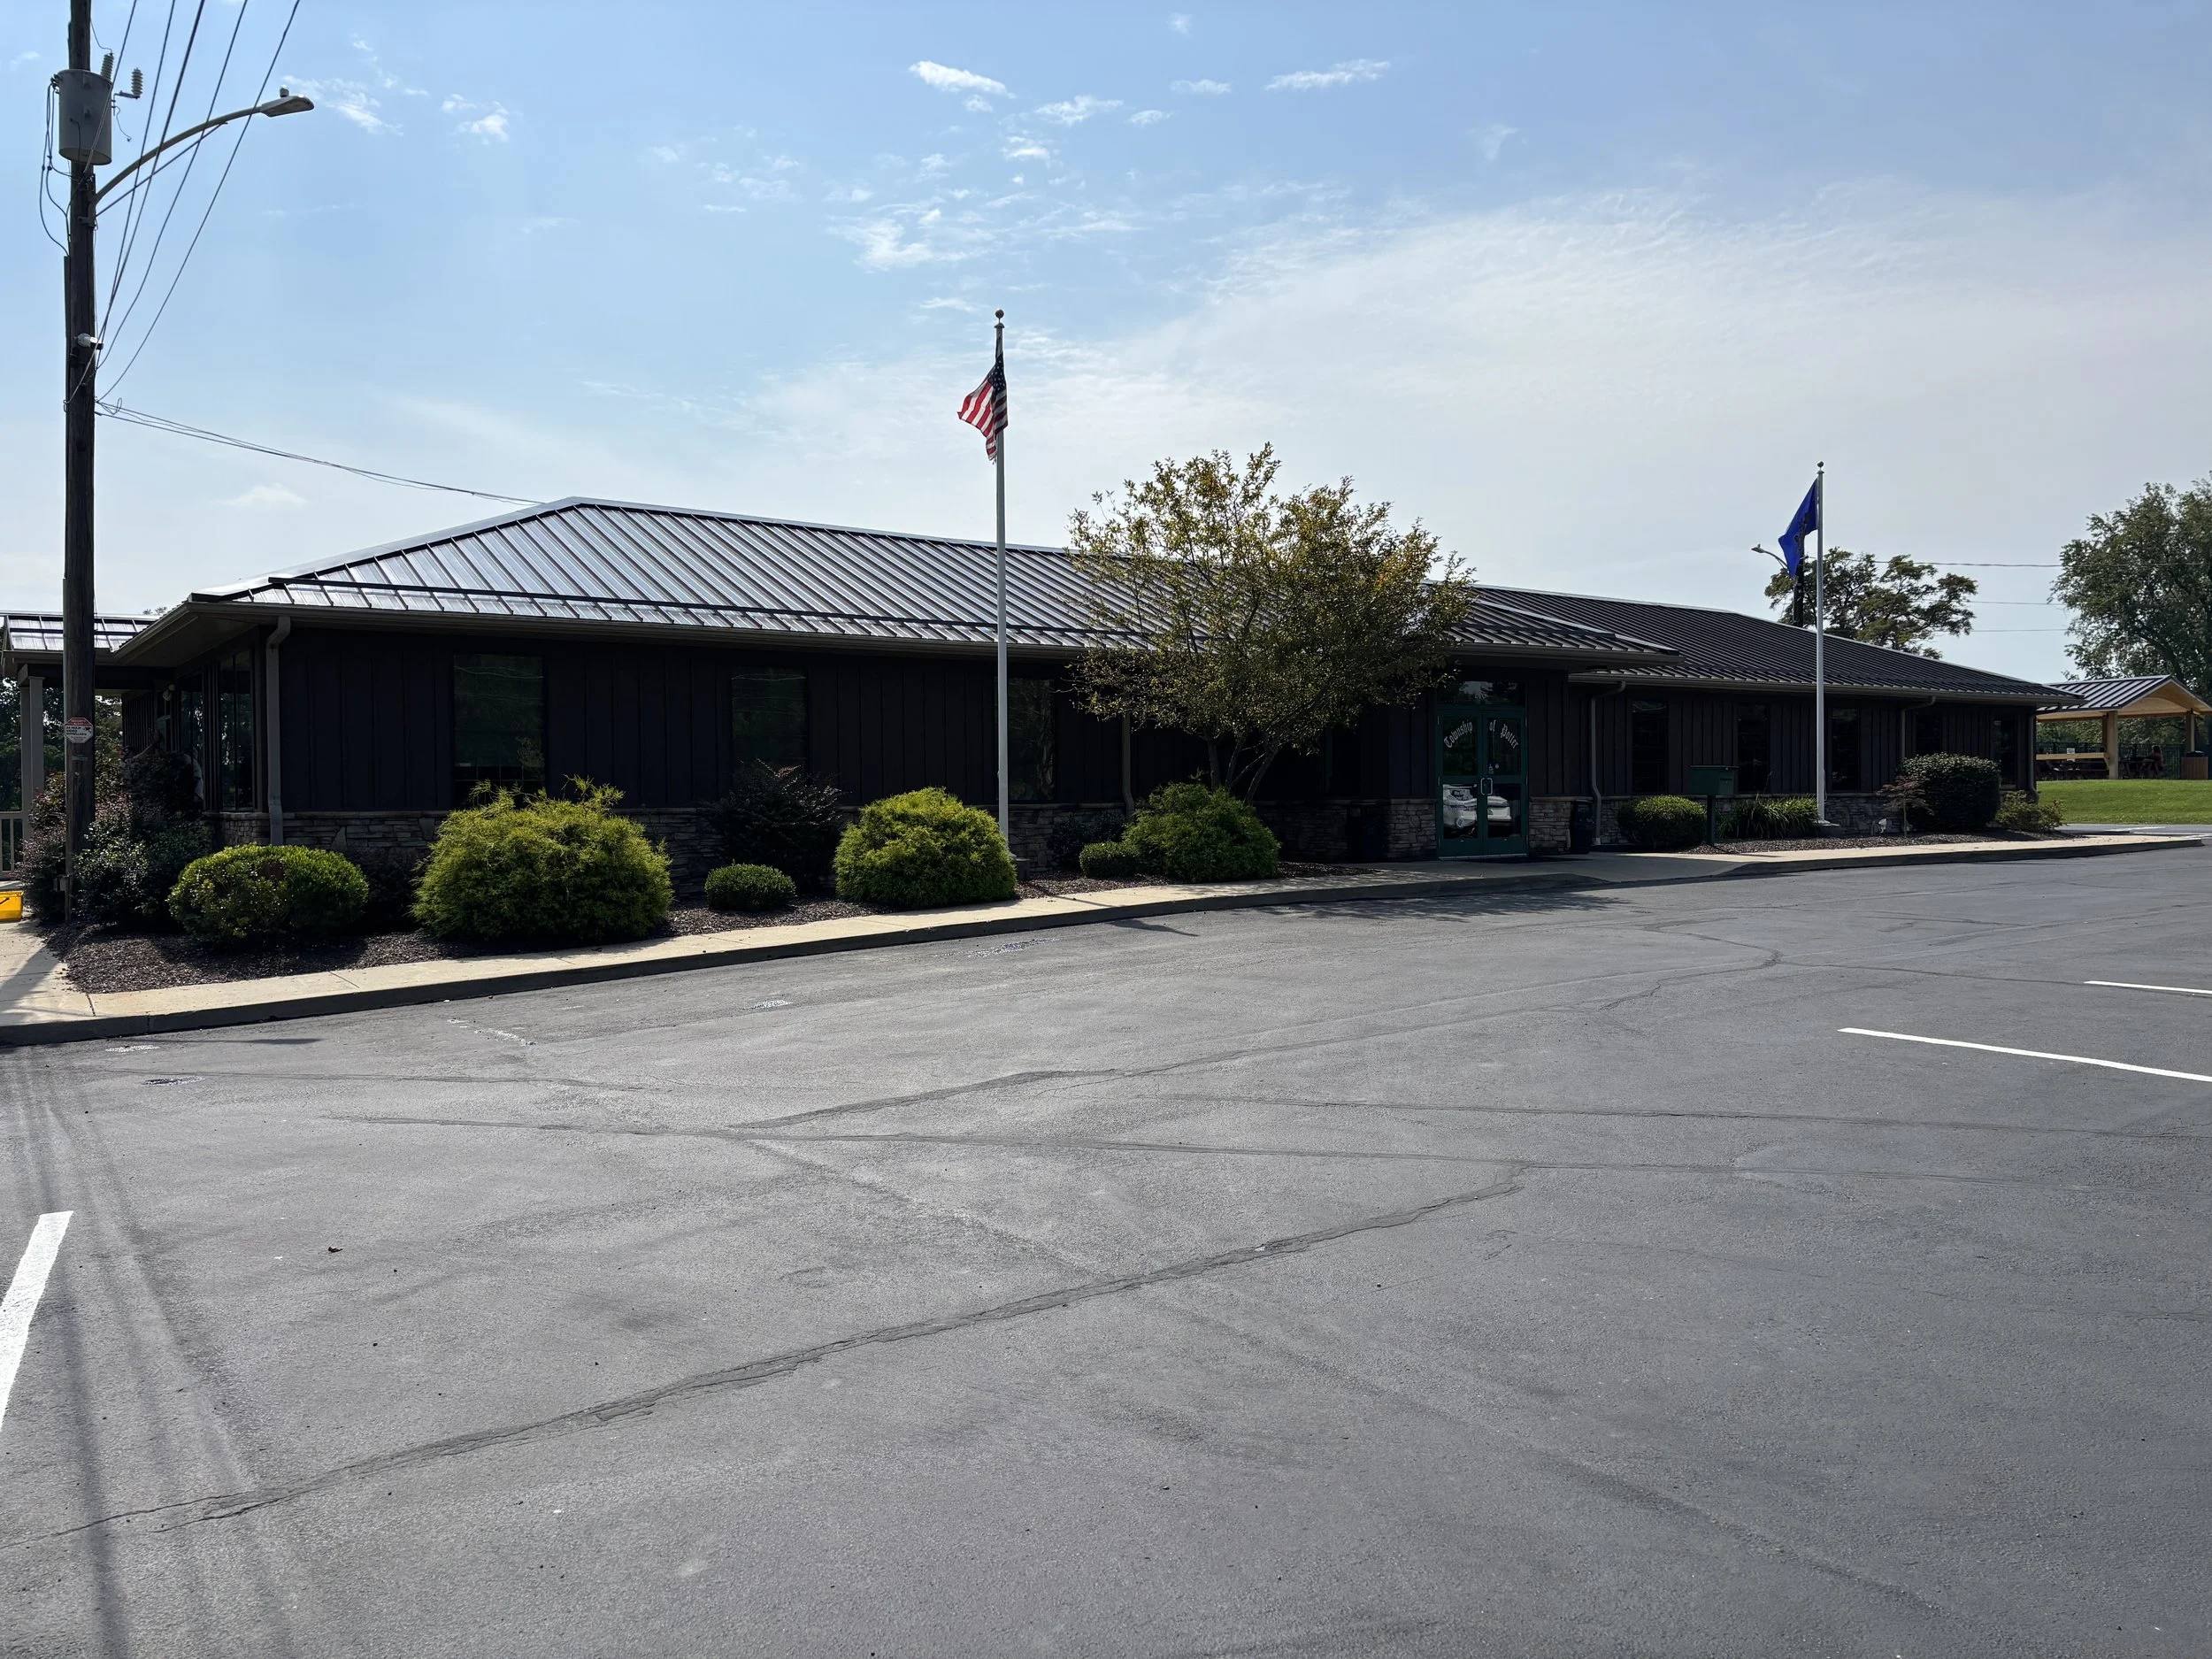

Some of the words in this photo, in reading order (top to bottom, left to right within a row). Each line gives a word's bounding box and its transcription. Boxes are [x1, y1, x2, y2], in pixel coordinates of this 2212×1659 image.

[1444, 718, 1473, 749] Township
[1489, 719, 1497, 732] of
[1500, 723, 1519, 749] Potter
